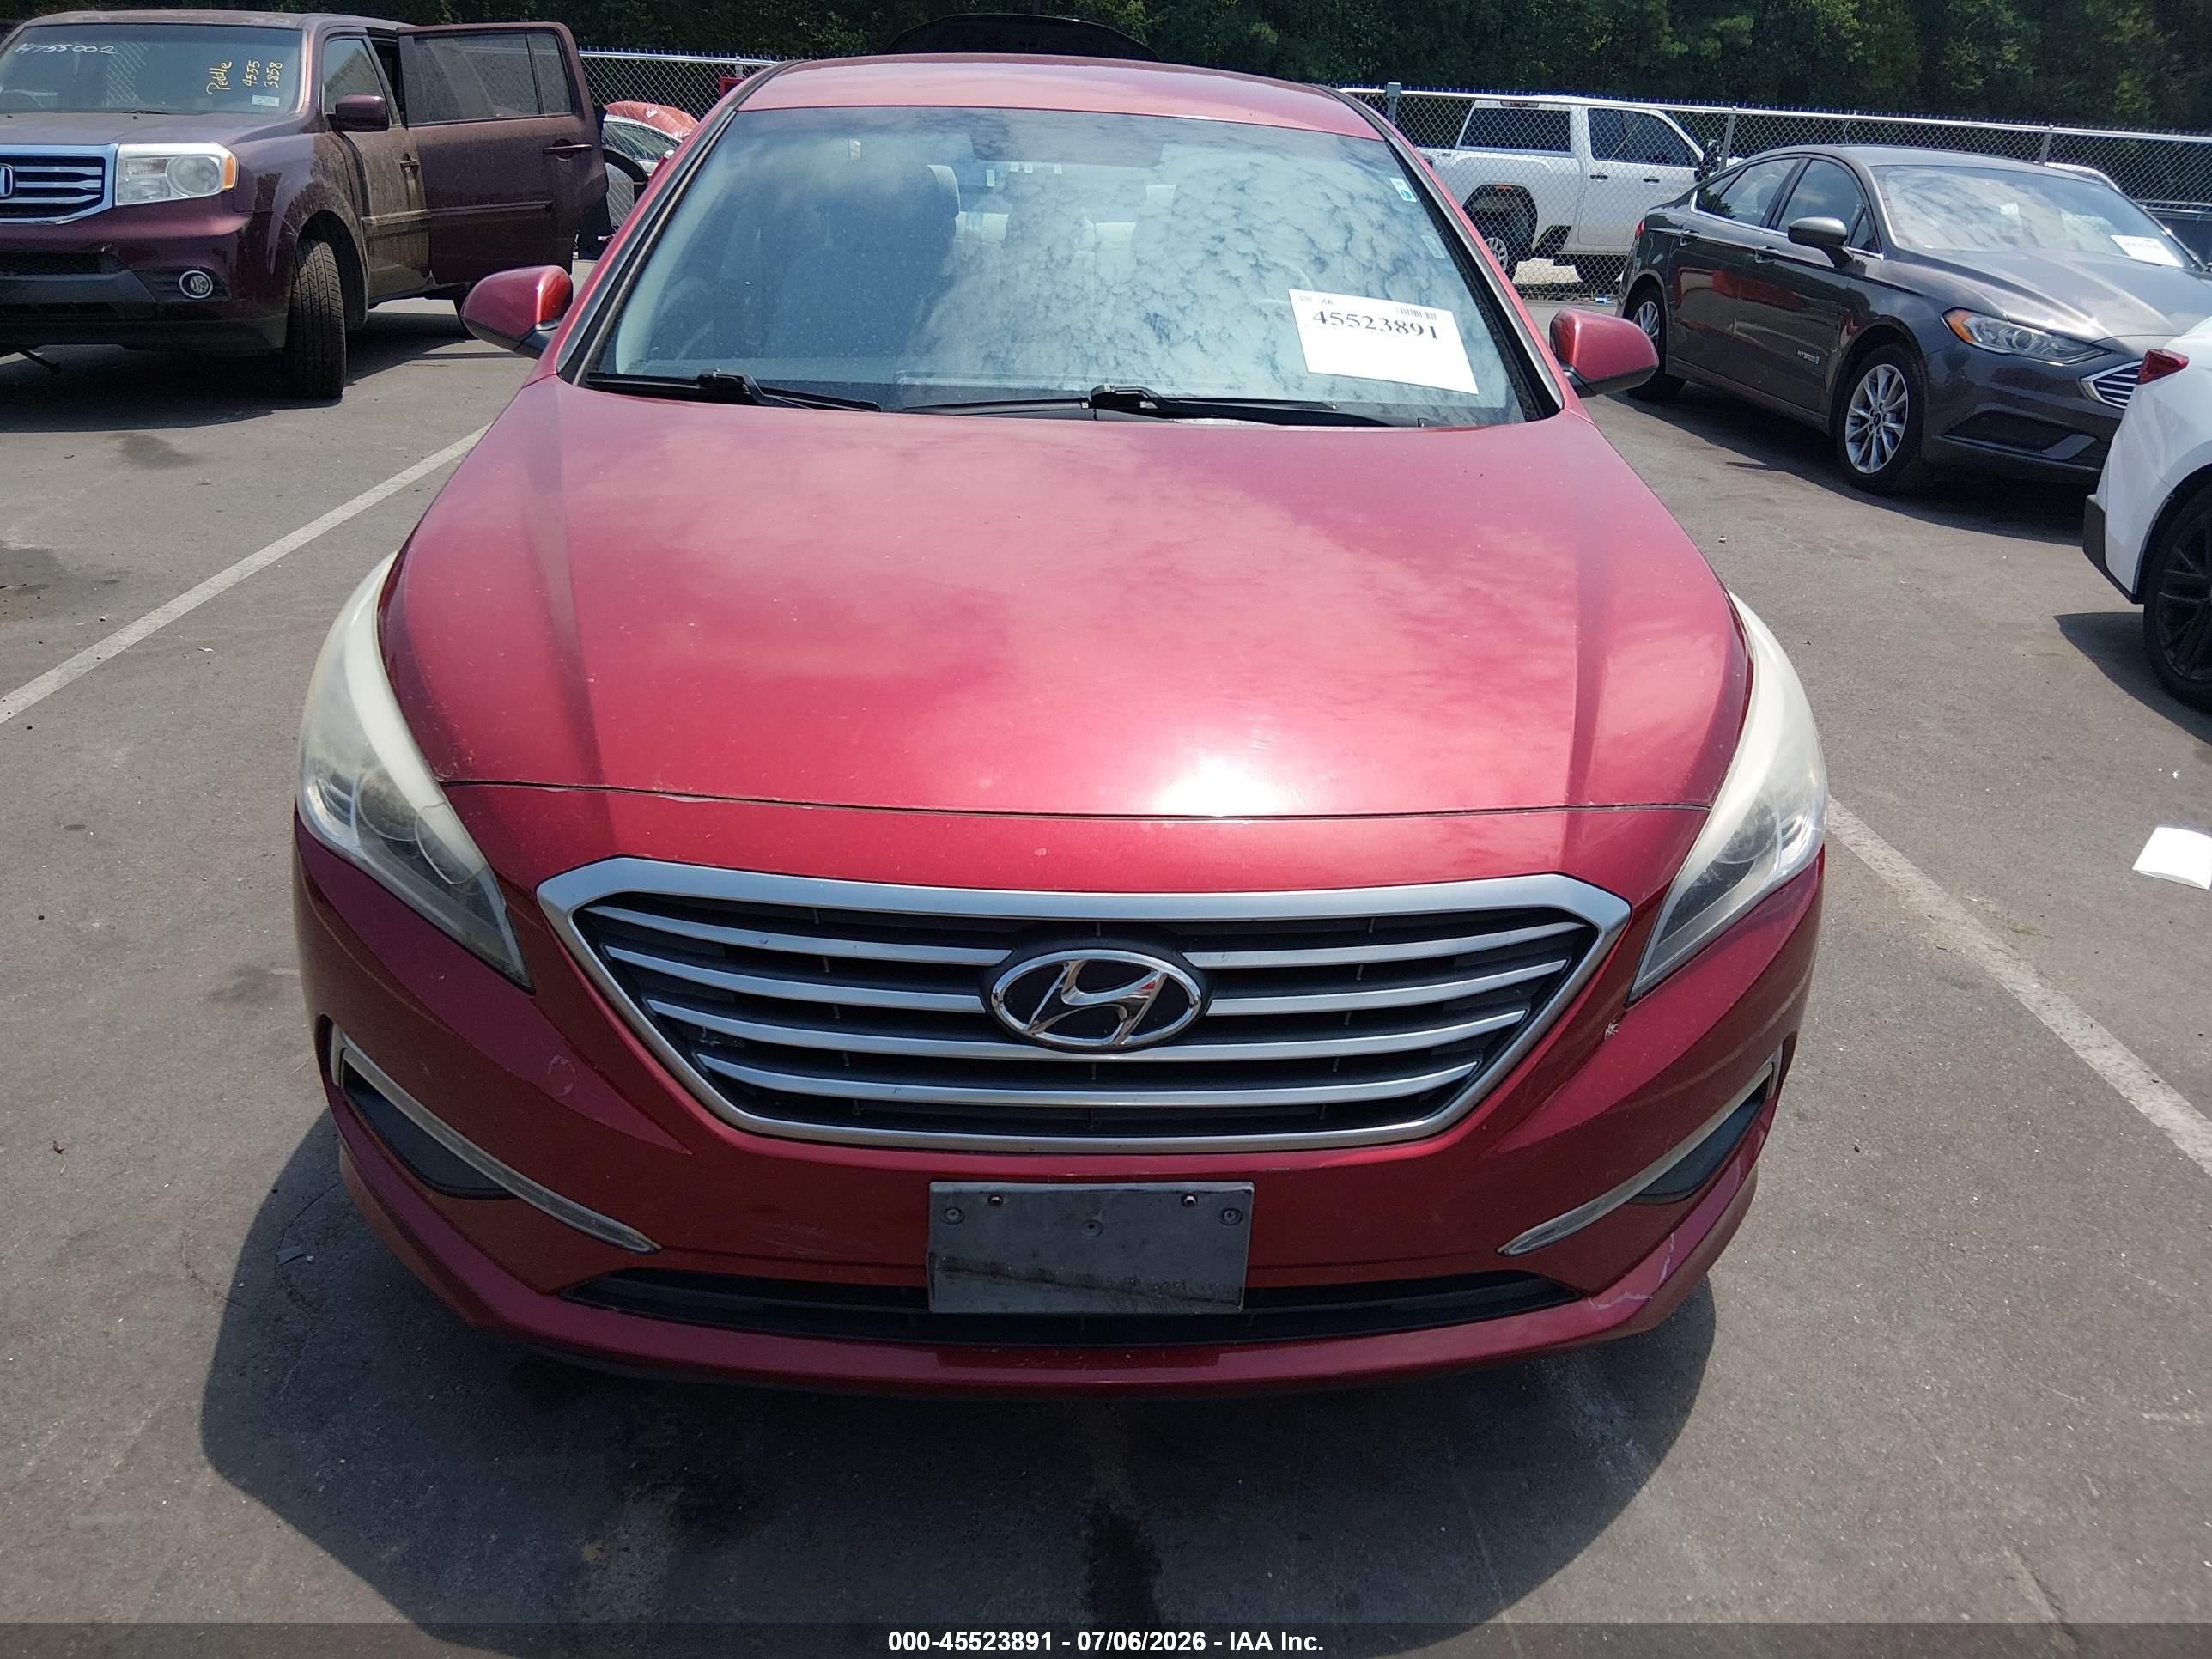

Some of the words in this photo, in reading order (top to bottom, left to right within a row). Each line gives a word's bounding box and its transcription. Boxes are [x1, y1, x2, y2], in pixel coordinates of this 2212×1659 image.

[206, 61, 233, 94] Peddle
[242, 60, 261, 87] 4555
[264, 62, 283, 88] 3858
[1312, 310, 1438, 340] 45523891
